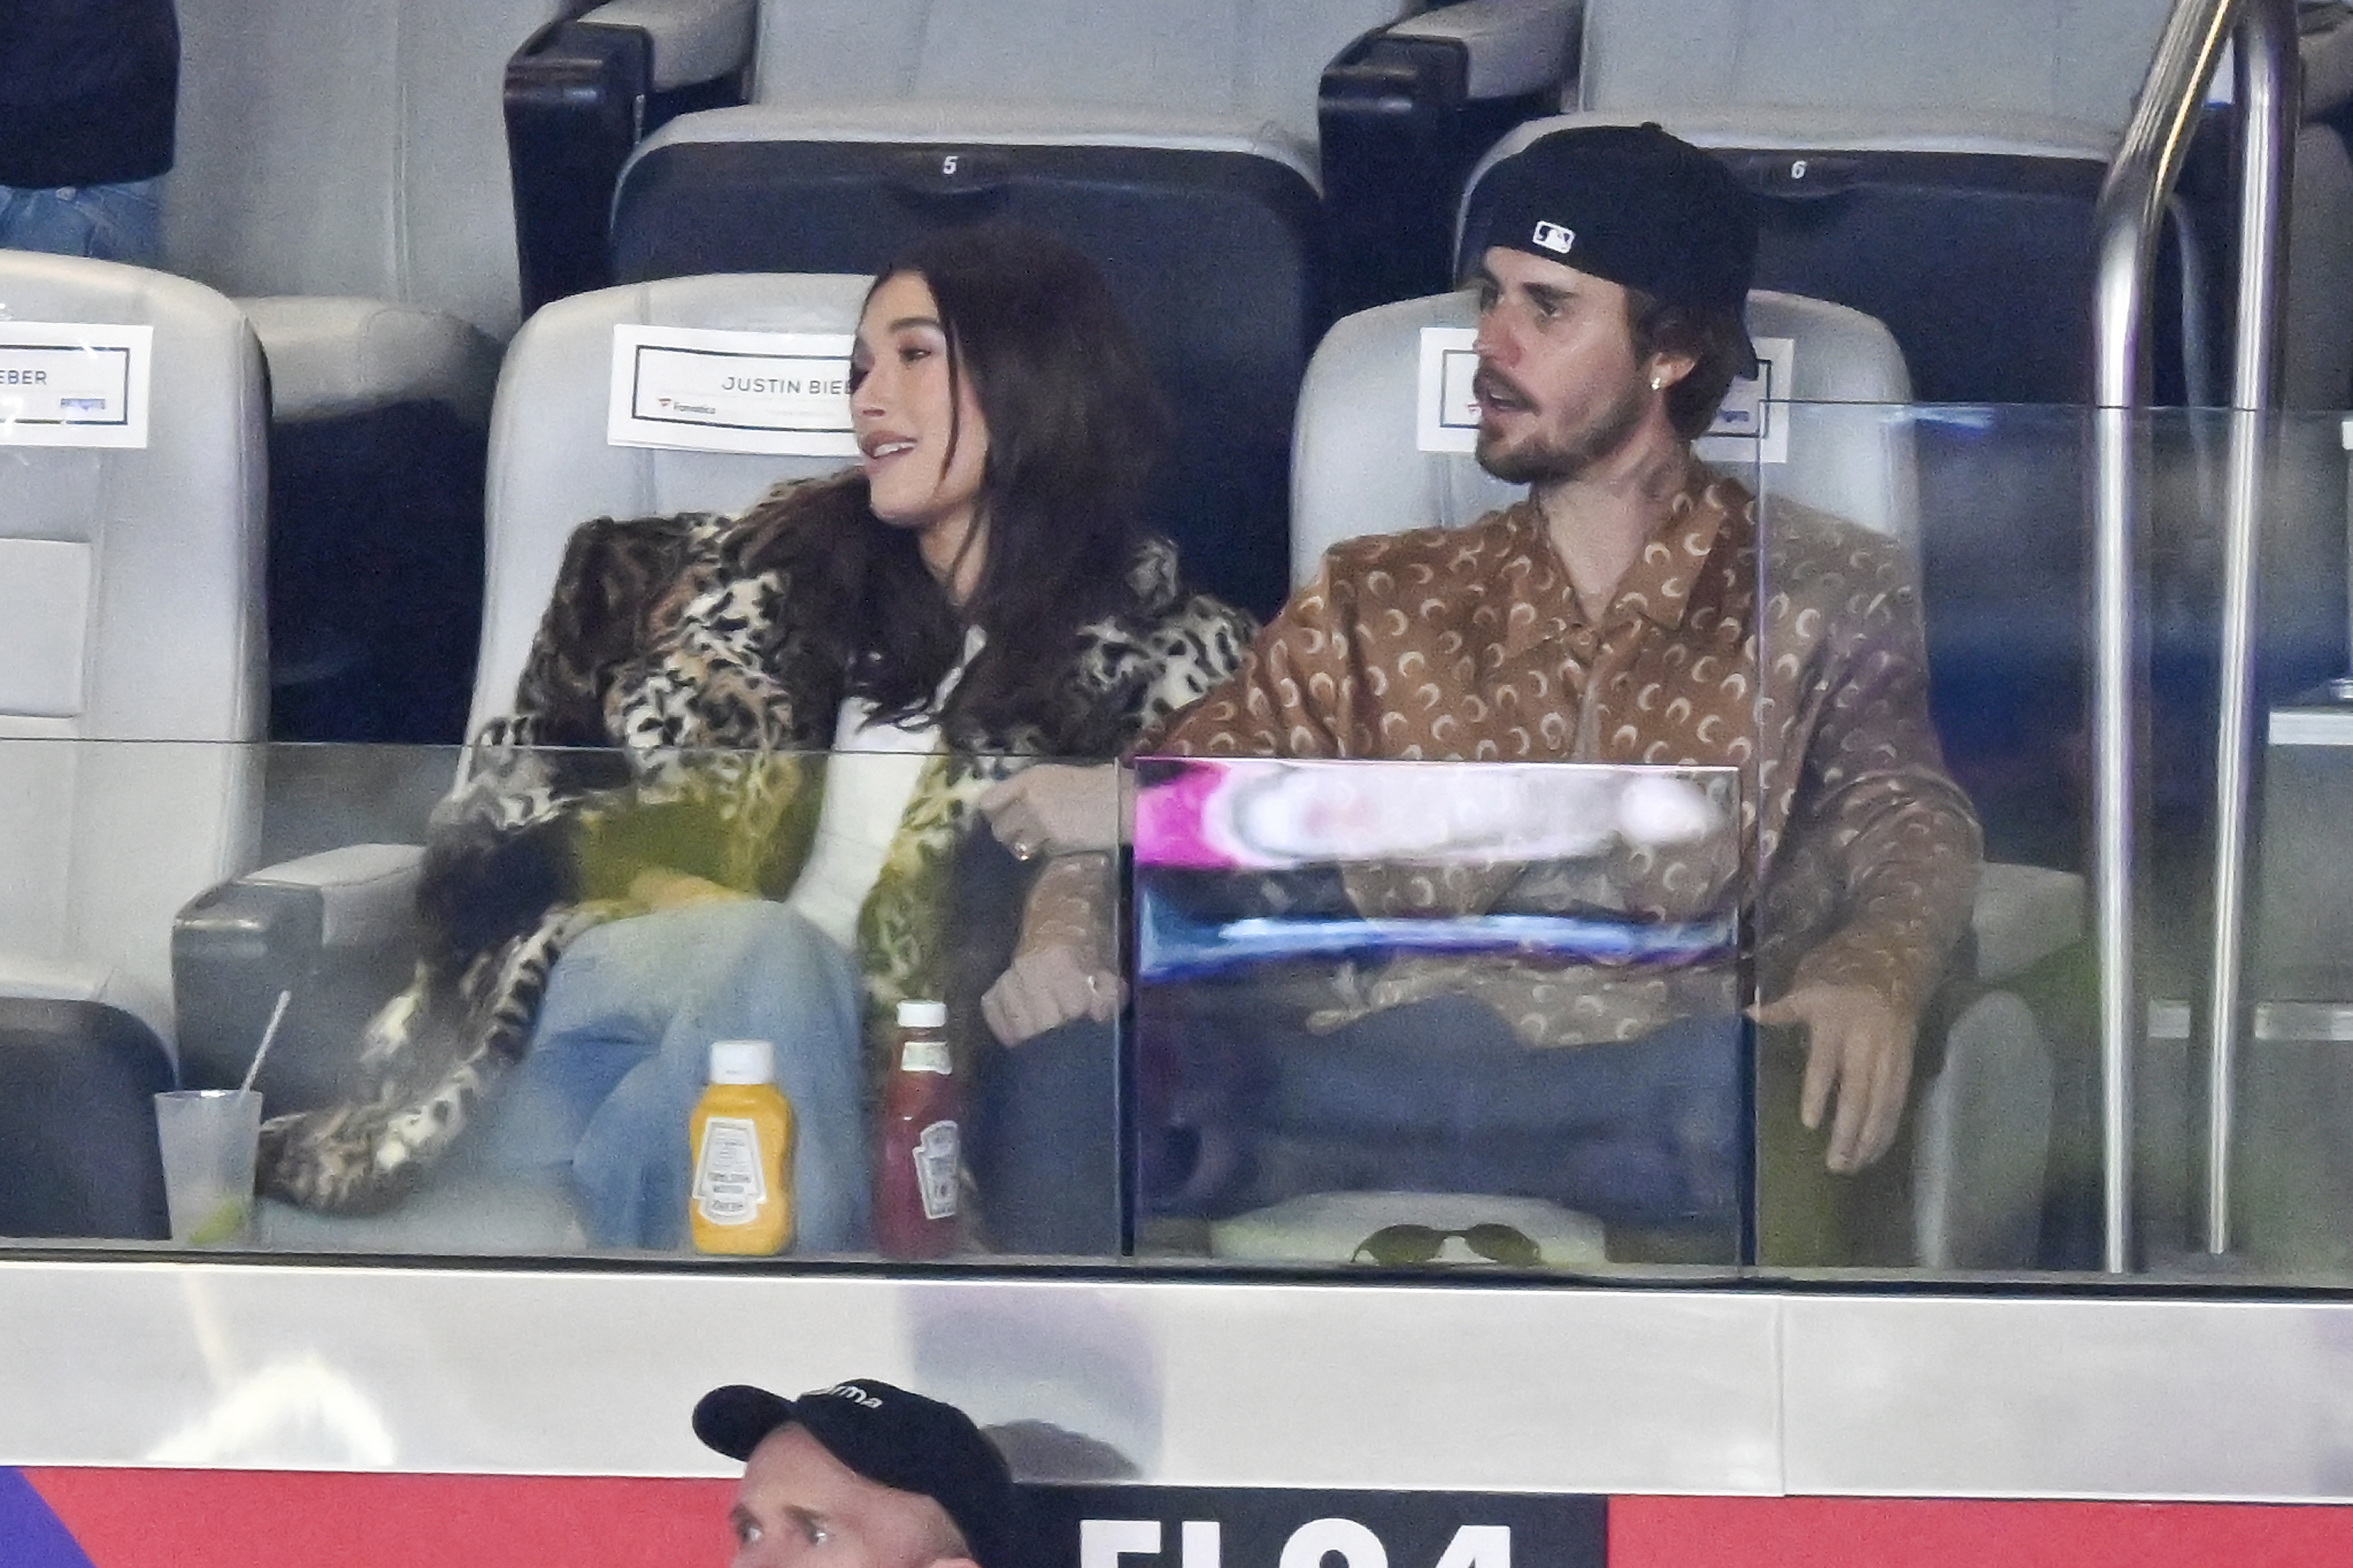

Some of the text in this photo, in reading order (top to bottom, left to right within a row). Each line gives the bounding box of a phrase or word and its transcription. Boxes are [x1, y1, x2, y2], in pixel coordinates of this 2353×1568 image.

[944, 155, 958, 174] 5
[1791, 160, 1806, 179] 6
[722, 376, 800, 394] JUSTIN
